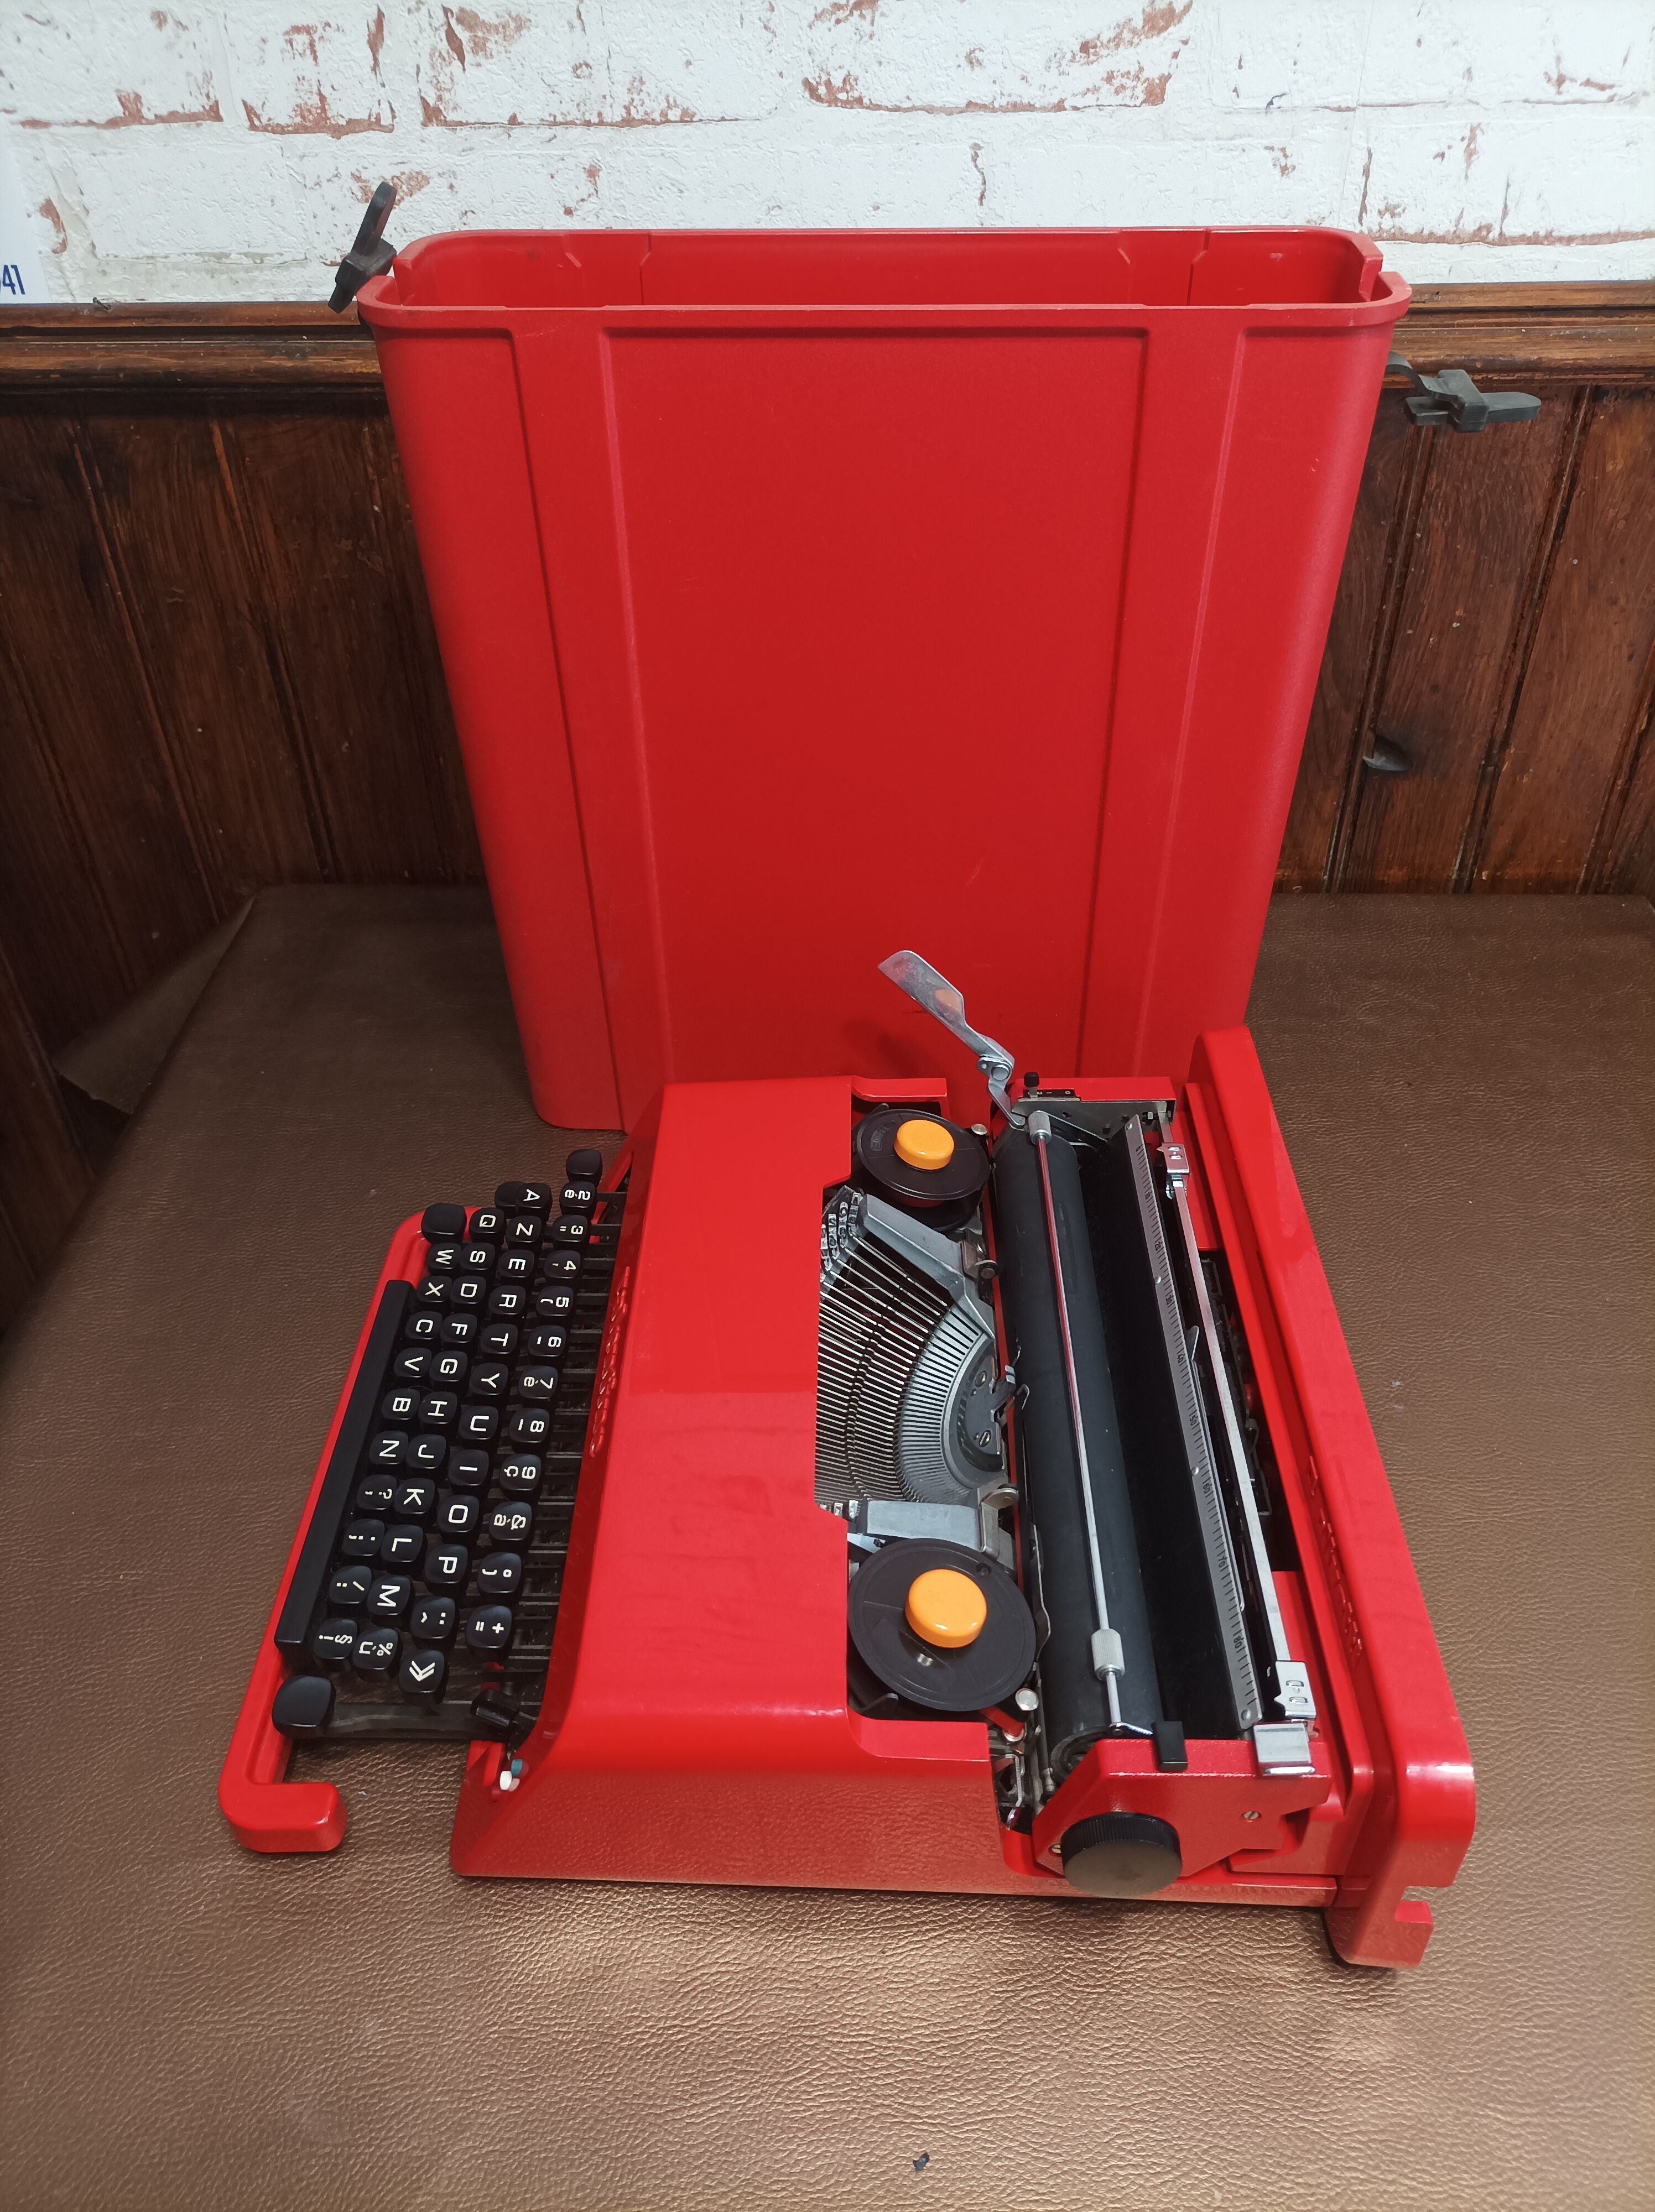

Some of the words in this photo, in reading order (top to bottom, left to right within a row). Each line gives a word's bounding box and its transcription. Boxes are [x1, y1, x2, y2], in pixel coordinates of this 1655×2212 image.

[0, 264, 25, 295] 41
[523, 1188, 540, 1202] A
[577, 1190, 591, 1201] 2
[479, 1214, 496, 1228] Q
[516, 1223, 534, 1236] Z
[570, 1225, 584, 1235] 3
[1154, 1241, 1162, 1251] 20
[435, 1249, 454, 1265] W
[470, 1250, 486, 1263] S
[508, 1258, 526, 1271] E
[564, 1260, 576, 1271] 4
[425, 1282, 444, 1297] X
[460, 1283, 478, 1297] D
[498, 1294, 517, 1308] R
[555, 1296, 570, 1308] 5
[1165, 1295, 1174, 1306] 30
[415, 1319, 434, 1333] C
[451, 1323, 468, 1335] F
[491, 1333, 509, 1347] T
[548, 1336, 562, 1348] 6
[404, 1356, 424, 1371] V
[440, 1358, 458, 1374] G
[1176, 1354, 1185, 1364] 40
[481, 1373, 500, 1389] Y
[540, 1377, 554, 1389] 7
[392, 1397, 412, 1412] B
[427, 1400, 447, 1417] H
[470, 1415, 490, 1432] U
[530, 1420, 545, 1433] 8
[1189, 1415, 1198, 1427] 50
[379, 1439, 400, 1458] N
[418, 1444, 434, 1459] J
[503, 1465, 519, 1477] ç
[521, 1466, 536, 1479] 9
[378, 1488, 393, 1499] ?
[1202, 1483, 1212, 1495] 60
[403, 1488, 425, 1506] K
[448, 1504, 469, 1524] O
[511, 1514, 527, 1530] &
[391, 1537, 412, 1552] L
[438, 1556, 458, 1574] P
[1217, 1556, 1227, 1568] 70
[377, 1584, 400, 1607] M
[475, 1621, 485, 1631] =
[492, 1623, 504, 1634] +
[335, 1634, 353, 1644] §
[1233, 1636, 1244, 1650] 80
[377, 1642, 393, 1656] %
